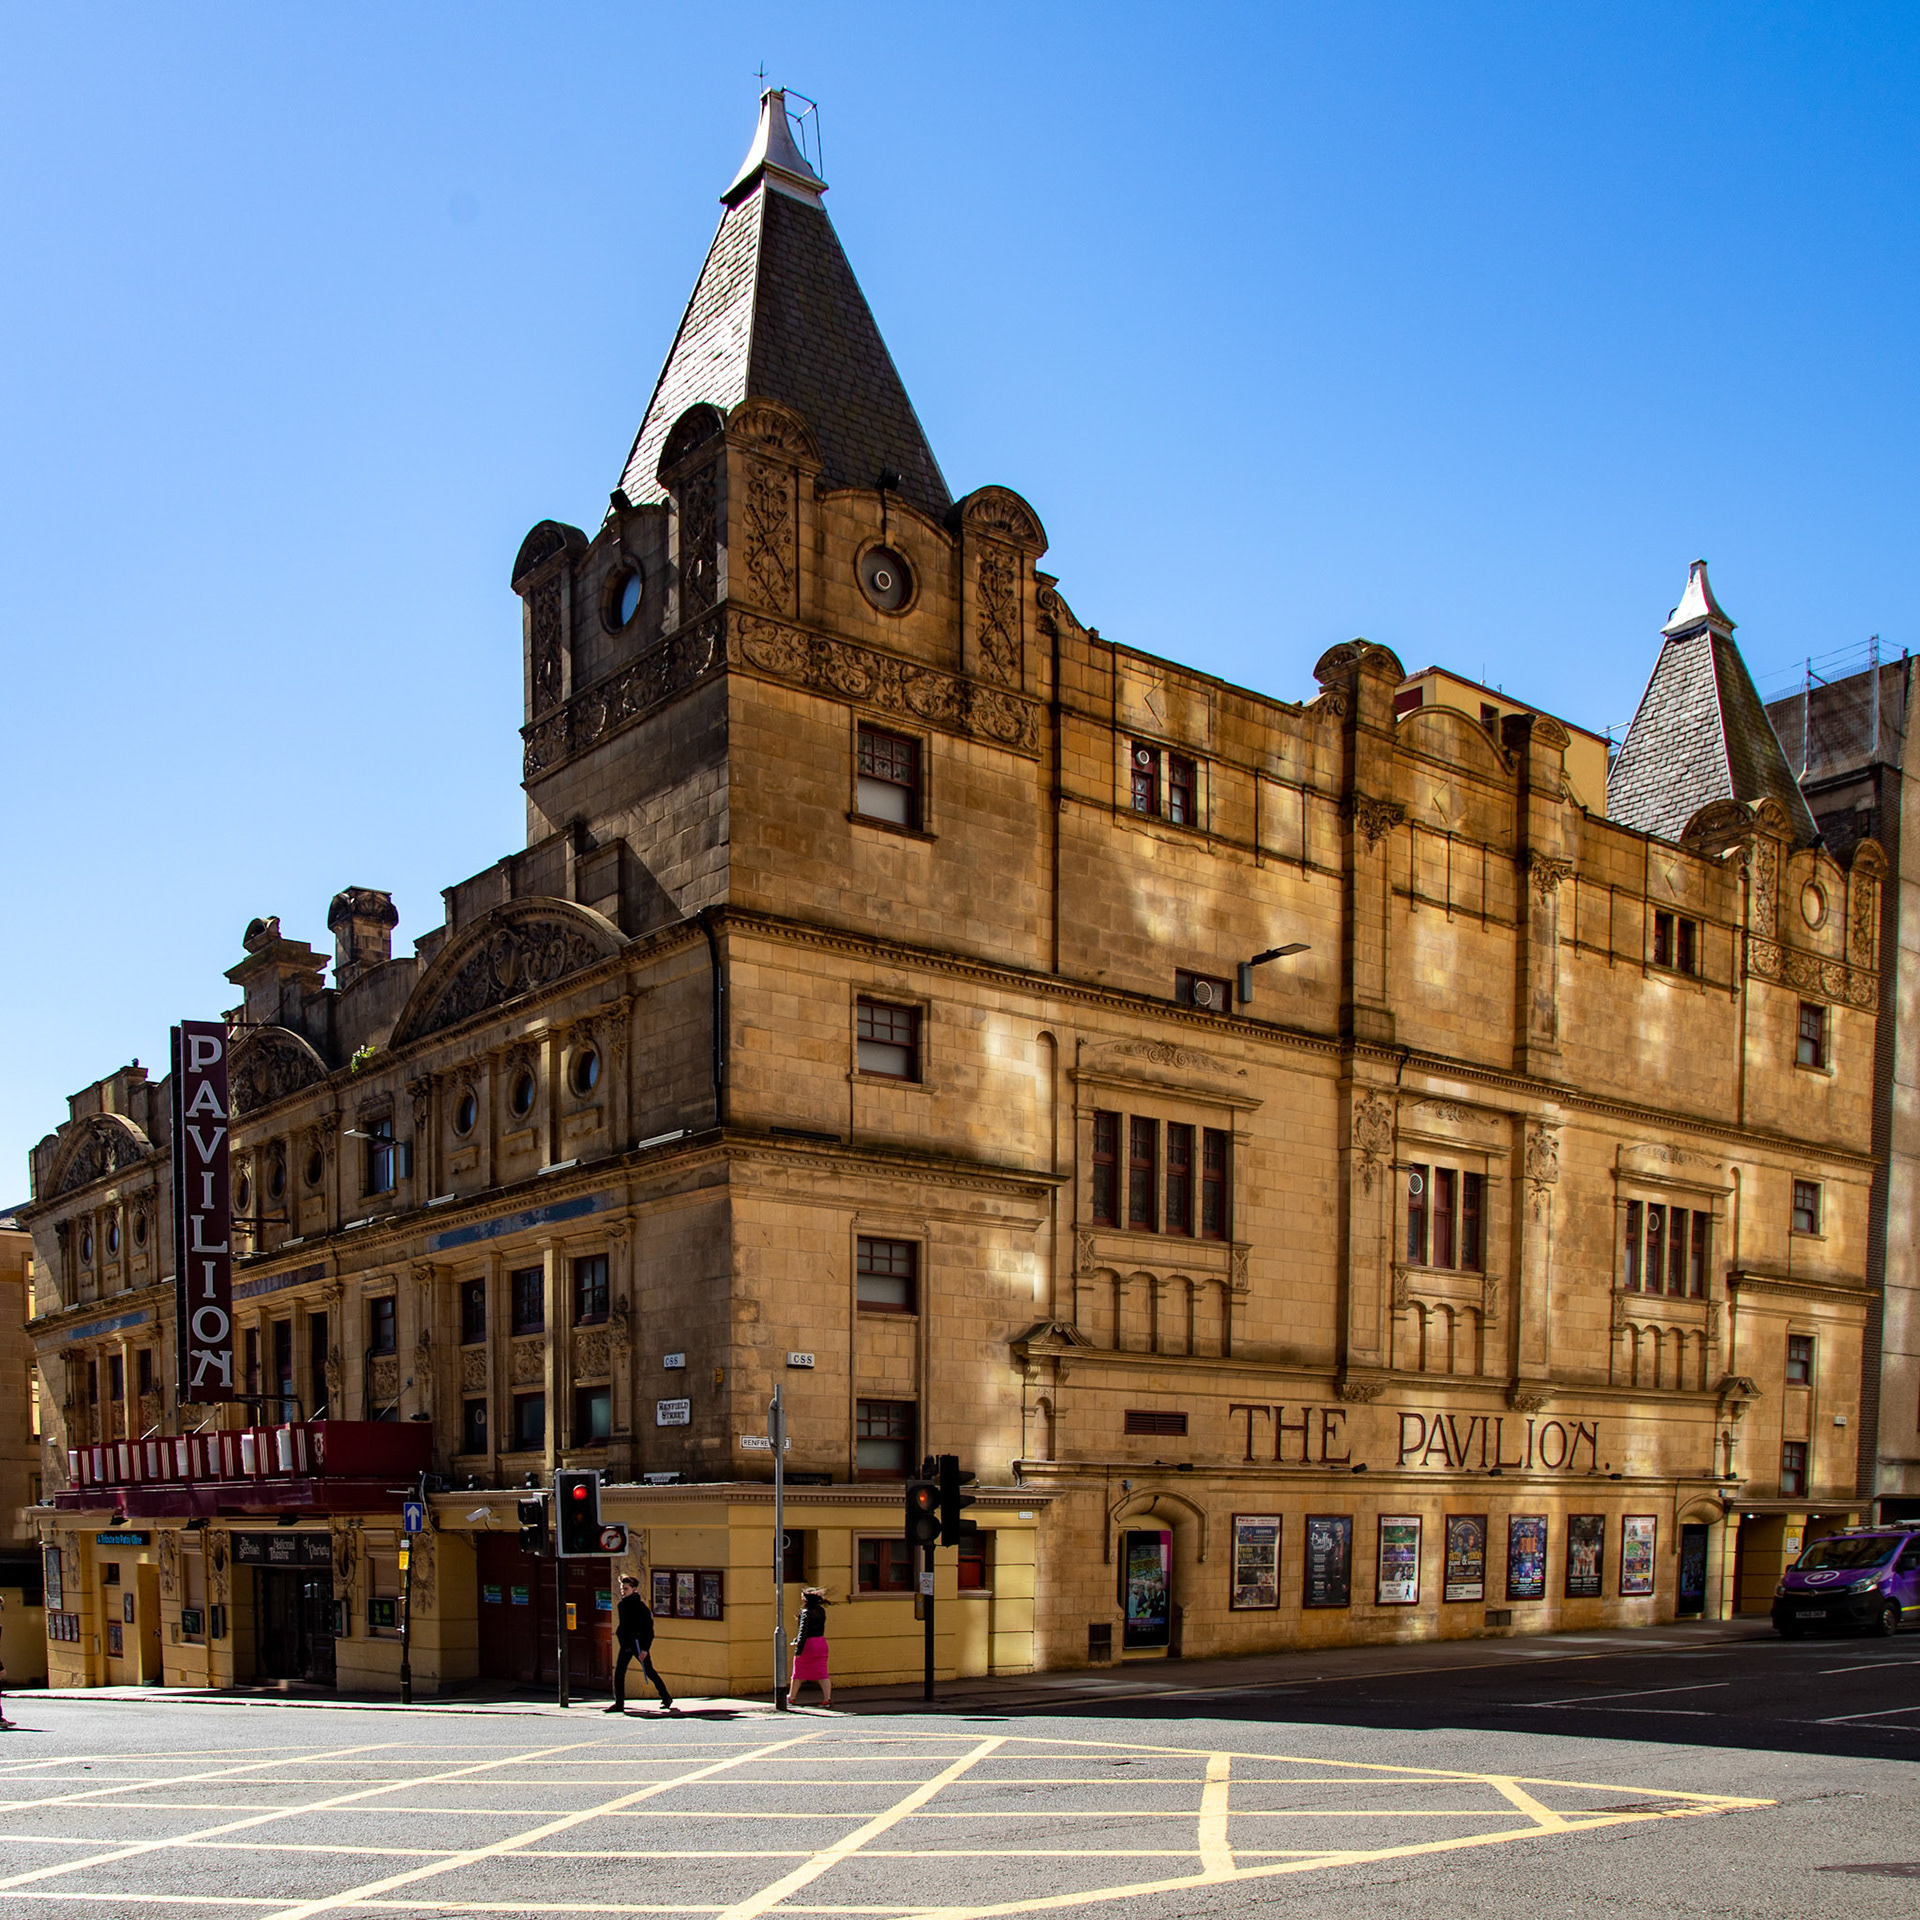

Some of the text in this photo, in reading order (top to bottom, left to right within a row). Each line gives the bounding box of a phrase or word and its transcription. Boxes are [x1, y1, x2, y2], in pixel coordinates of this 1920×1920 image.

[185, 1034, 233, 1387] PAVILION
[793, 1355, 812, 1364] CSS
[662, 1411, 685, 1420] STREET
[1229, 1404, 1351, 1464] THE
[273, 1536, 296, 1551] National
[303, 1537, 309, 1549] of
[269, 1547, 289, 1560] Theatre
[309, 1543, 330, 1560] Variety
[1810, 1573, 1834, 1581] BT
